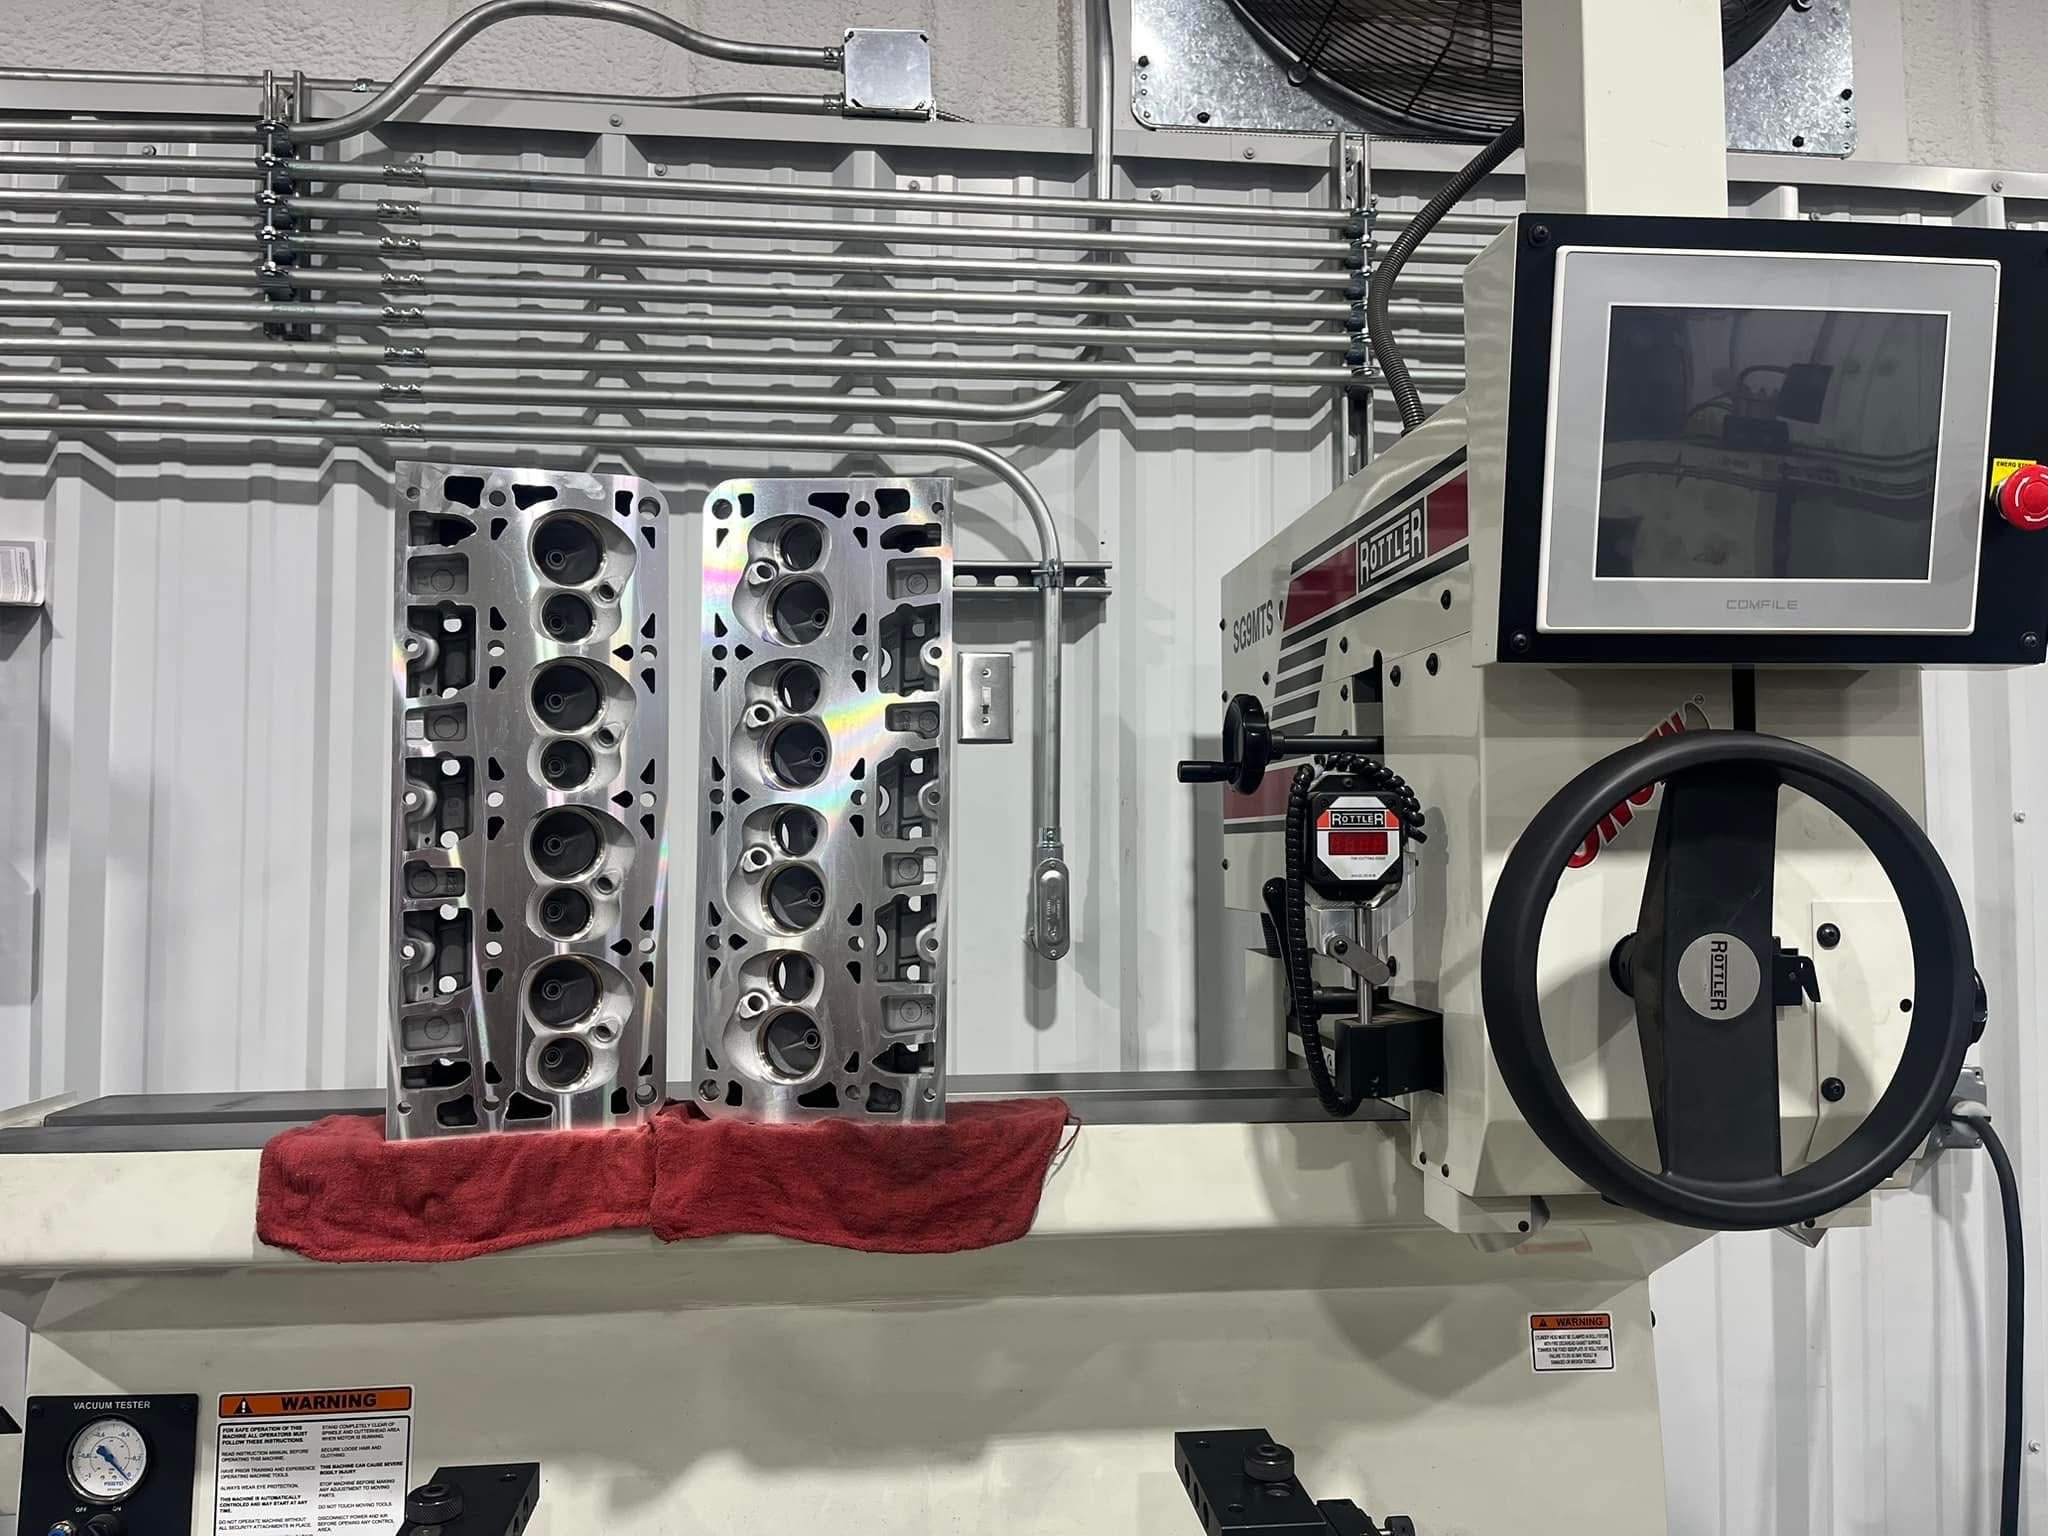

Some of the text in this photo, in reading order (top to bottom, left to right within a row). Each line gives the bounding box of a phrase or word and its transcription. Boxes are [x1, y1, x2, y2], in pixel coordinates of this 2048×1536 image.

[1360, 508, 1422, 585] ROTTLER
[1727, 600, 1798, 609] COMFILE
[1233, 599, 1274, 653] SG9MTS
[1332, 813, 1384, 825] ROTTLER
[1711, 941, 1728, 1010] ROTTLER
[1556, 1318, 1603, 1326] WARNING
[73, 1401, 151, 1410] VACUUM TESTER
[281, 1394, 376, 1410] WARNING
